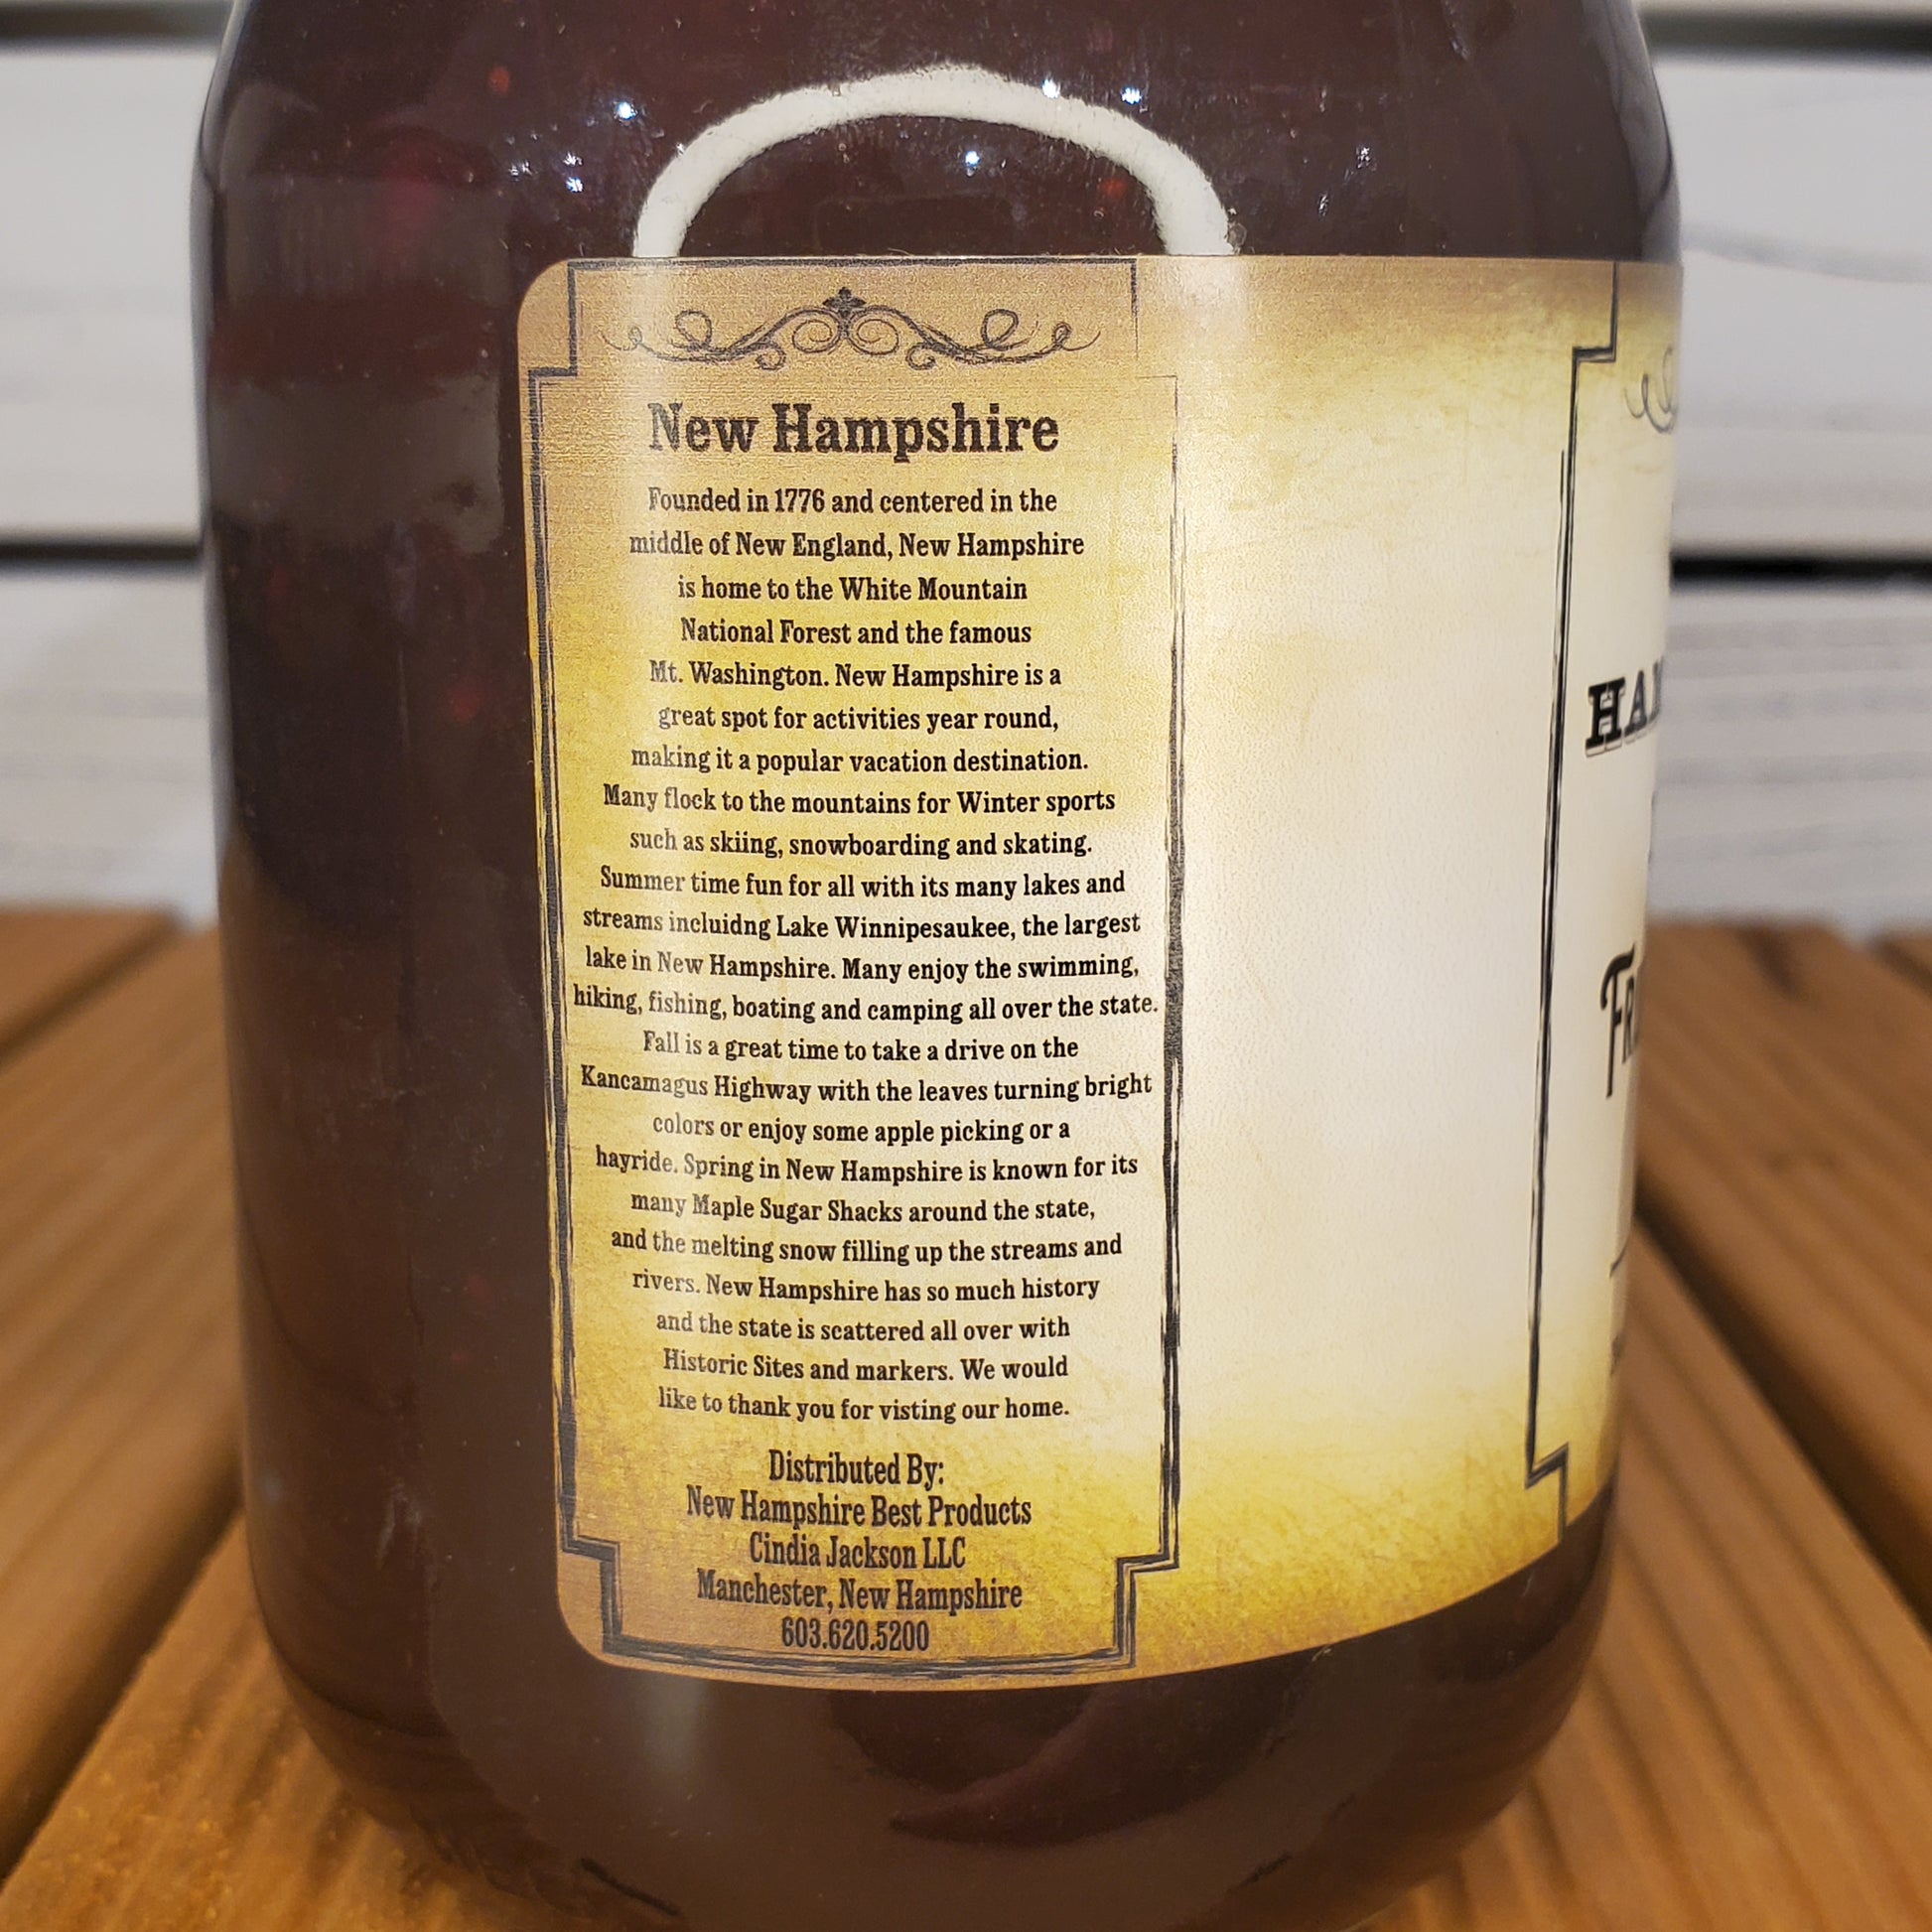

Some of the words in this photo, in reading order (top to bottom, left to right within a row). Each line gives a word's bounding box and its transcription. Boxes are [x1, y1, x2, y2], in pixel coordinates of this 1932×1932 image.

[647, 402, 759, 453] New
[771, 401, 1058, 464] Hampshire
[649, 486, 741, 512] Founded
[774, 488, 825, 513] 1776
[832, 488, 874, 513] and
[880, 487, 984, 513] centered
[1019, 487, 1057, 512] the
[629, 530, 703, 555] middle
[736, 531, 786, 556] New
[791, 532, 893, 562] England,
[898, 532, 951, 557] New
[957, 531, 1084, 561] Hampshire
[701, 575, 761, 600] home
[795, 576, 833, 601] the
[839, 577, 911, 601] White
[917, 576, 1028, 601] Mountain
[681, 617, 773, 643] National
[779, 620, 852, 644] Forest
[858, 620, 898, 644] and
[905, 620, 943, 644] the
[949, 621, 1032, 643] famous
[688, 661, 829, 691] Washington.
[835, 663, 887, 687] New
[892, 663, 1019, 692] Hampshire
[659, 707, 716, 729] great
[722, 708, 768, 732] spot
[774, 706, 807, 729] for
[813, 707, 920, 730] activities
[926, 713, 978, 735] year
[984, 705, 1058, 732] round,
[631, 745, 711, 773] making
[757, 748, 844, 775] popular
[849, 749, 947, 772] vacation
[953, 748, 1088, 771] destination.
[603, 783, 658, 812] Many
[664, 787, 717, 810] flock
[749, 789, 785, 812] the
[792, 791, 910, 814] mountains
[917, 791, 951, 814] for
[956, 791, 1040, 813] Winter
[1046, 790, 1115, 817] sports
[710, 830, 783, 859] skiing,
[789, 833, 950, 860] snowboarding
[956, 832, 997, 856] and
[1003, 831, 1092, 857] skating.
[601, 865, 685, 892] Summer
[691, 871, 740, 895] time
[746, 873, 783, 896] fun
[788, 874, 822, 897] for
[828, 875, 855, 897] all
[861, 875, 914, 897] with
[920, 875, 949, 897] its
[955, 881, 1018, 900] many
[1024, 873, 1080, 896] lakes
[1086, 870, 1125, 894] and
[584, 907, 662, 930] streams
[669, 911, 771, 941] incluidng
[776, 914, 828, 937] Lake
[834, 915, 1016, 943] Winnipesaukee,
[1023, 914, 1058, 936] the
[1064, 913, 1141, 938] largest
[586, 945, 626, 970] lake
[710, 954, 836, 982] Hampshire.
[842, 958, 902, 984] Many
[908, 958, 969, 984] enjoy
[975, 957, 1012, 979] the
[1018, 953, 1139, 978] swimming,
[573, 983, 642, 1015] hiking,
[649, 991, 727, 1021] fishing,
[732, 995, 815, 1024] boating
[821, 998, 862, 1020] and
[868, 999, 963, 1025] camping
[969, 997, 996, 1020] all
[1002, 1002, 1052, 1020] over
[1057, 995, 1093, 1018] the
[1099, 994, 1158, 1016] state.
[726, 1038, 782, 1061] great
[788, 1037, 838, 1060] time
[872, 1038, 920, 1061] take
[945, 1038, 1004, 1061] drive
[1042, 1035, 1078, 1058] the
[581, 1064, 708, 1098] Kancamagus
[714, 1075, 811, 1105] Highway
[818, 1079, 870, 1101] with
[876, 1079, 912, 1102] the
[918, 1079, 988, 1101] leaves
[994, 1077, 1080, 1102] turning
[1084, 1072, 1152, 1099] bright
[653, 1113, 714, 1136] colors
[749, 1118, 807, 1145] enjoy
[813, 1125, 869, 1142] some
[875, 1120, 934, 1147] apple
[940, 1119, 1024, 1147] picking
[596, 1145, 678, 1173] hayride.
[685, 1154, 754, 1182] Spring
[786, 1158, 835, 1180] New
[841, 1160, 963, 1186] Hampshire
[993, 1159, 1068, 1180] known
[1074, 1156, 1106, 1177] for
[1112, 1154, 1138, 1174] its
[630, 1192, 687, 1217] many
[693, 1193, 755, 1221] Maple
[760, 1197, 822, 1224] Sugar
[828, 1199, 902, 1222] Shacks
[908, 1199, 987, 1222] around
[994, 1198, 1030, 1221] the
[1035, 1198, 1095, 1220] state,
[612, 1228, 647, 1250] and
[692, 1234, 774, 1263] melting
[779, 1244, 837, 1262] snow
[842, 1240, 909, 1267] filling
[948, 1239, 985, 1262] the
[991, 1241, 1077, 1261] streams
[1084, 1232, 1122, 1257] and
[631, 1269, 700, 1294] rivers.
[706, 1274, 753, 1297] New
[759, 1276, 879, 1305] Hampshire
[885, 1280, 921, 1302] has
[955, 1278, 1016, 1301] much
[1022, 1278, 1100, 1300] history
[739, 1318, 791, 1338] state
[821, 1319, 924, 1341] scattered
[930, 1319, 957, 1341] all
[964, 1324, 1013, 1340] over
[1019, 1315, 1070, 1338] with
[663, 1348, 748, 1375] Historic
[754, 1354, 804, 1379] Sites
[810, 1358, 850, 1380] and
[856, 1359, 953, 1381] markers.
[960, 1358, 995, 1380] We
[1001, 1355, 1068, 1379] would
[728, 1393, 791, 1417] thank
[796, 1403, 835, 1422] you
[841, 1398, 874, 1420] for
[879, 1399, 956, 1425] visting
[962, 1404, 1000, 1420] our
[1005, 1397, 1069, 1419] home.
[768, 1449, 900, 1484] Distributed
[906, 1453, 943, 1491] By:
[686, 1484, 735, 1519] New
[740, 1489, 866, 1530] Hampshire
[871, 1495, 922, 1527] Best
[927, 1493, 1032, 1527] Products
[750, 1531, 821, 1567] Cindia
[826, 1536, 917, 1569] Jackson
[922, 1536, 965, 1569] LLC
[697, 1568, 833, 1613] Manchester,
[839, 1578, 891, 1609] New
[896, 1578, 1023, 1616] Hampshire
[781, 1616, 930, 1652] 603.620.5200
